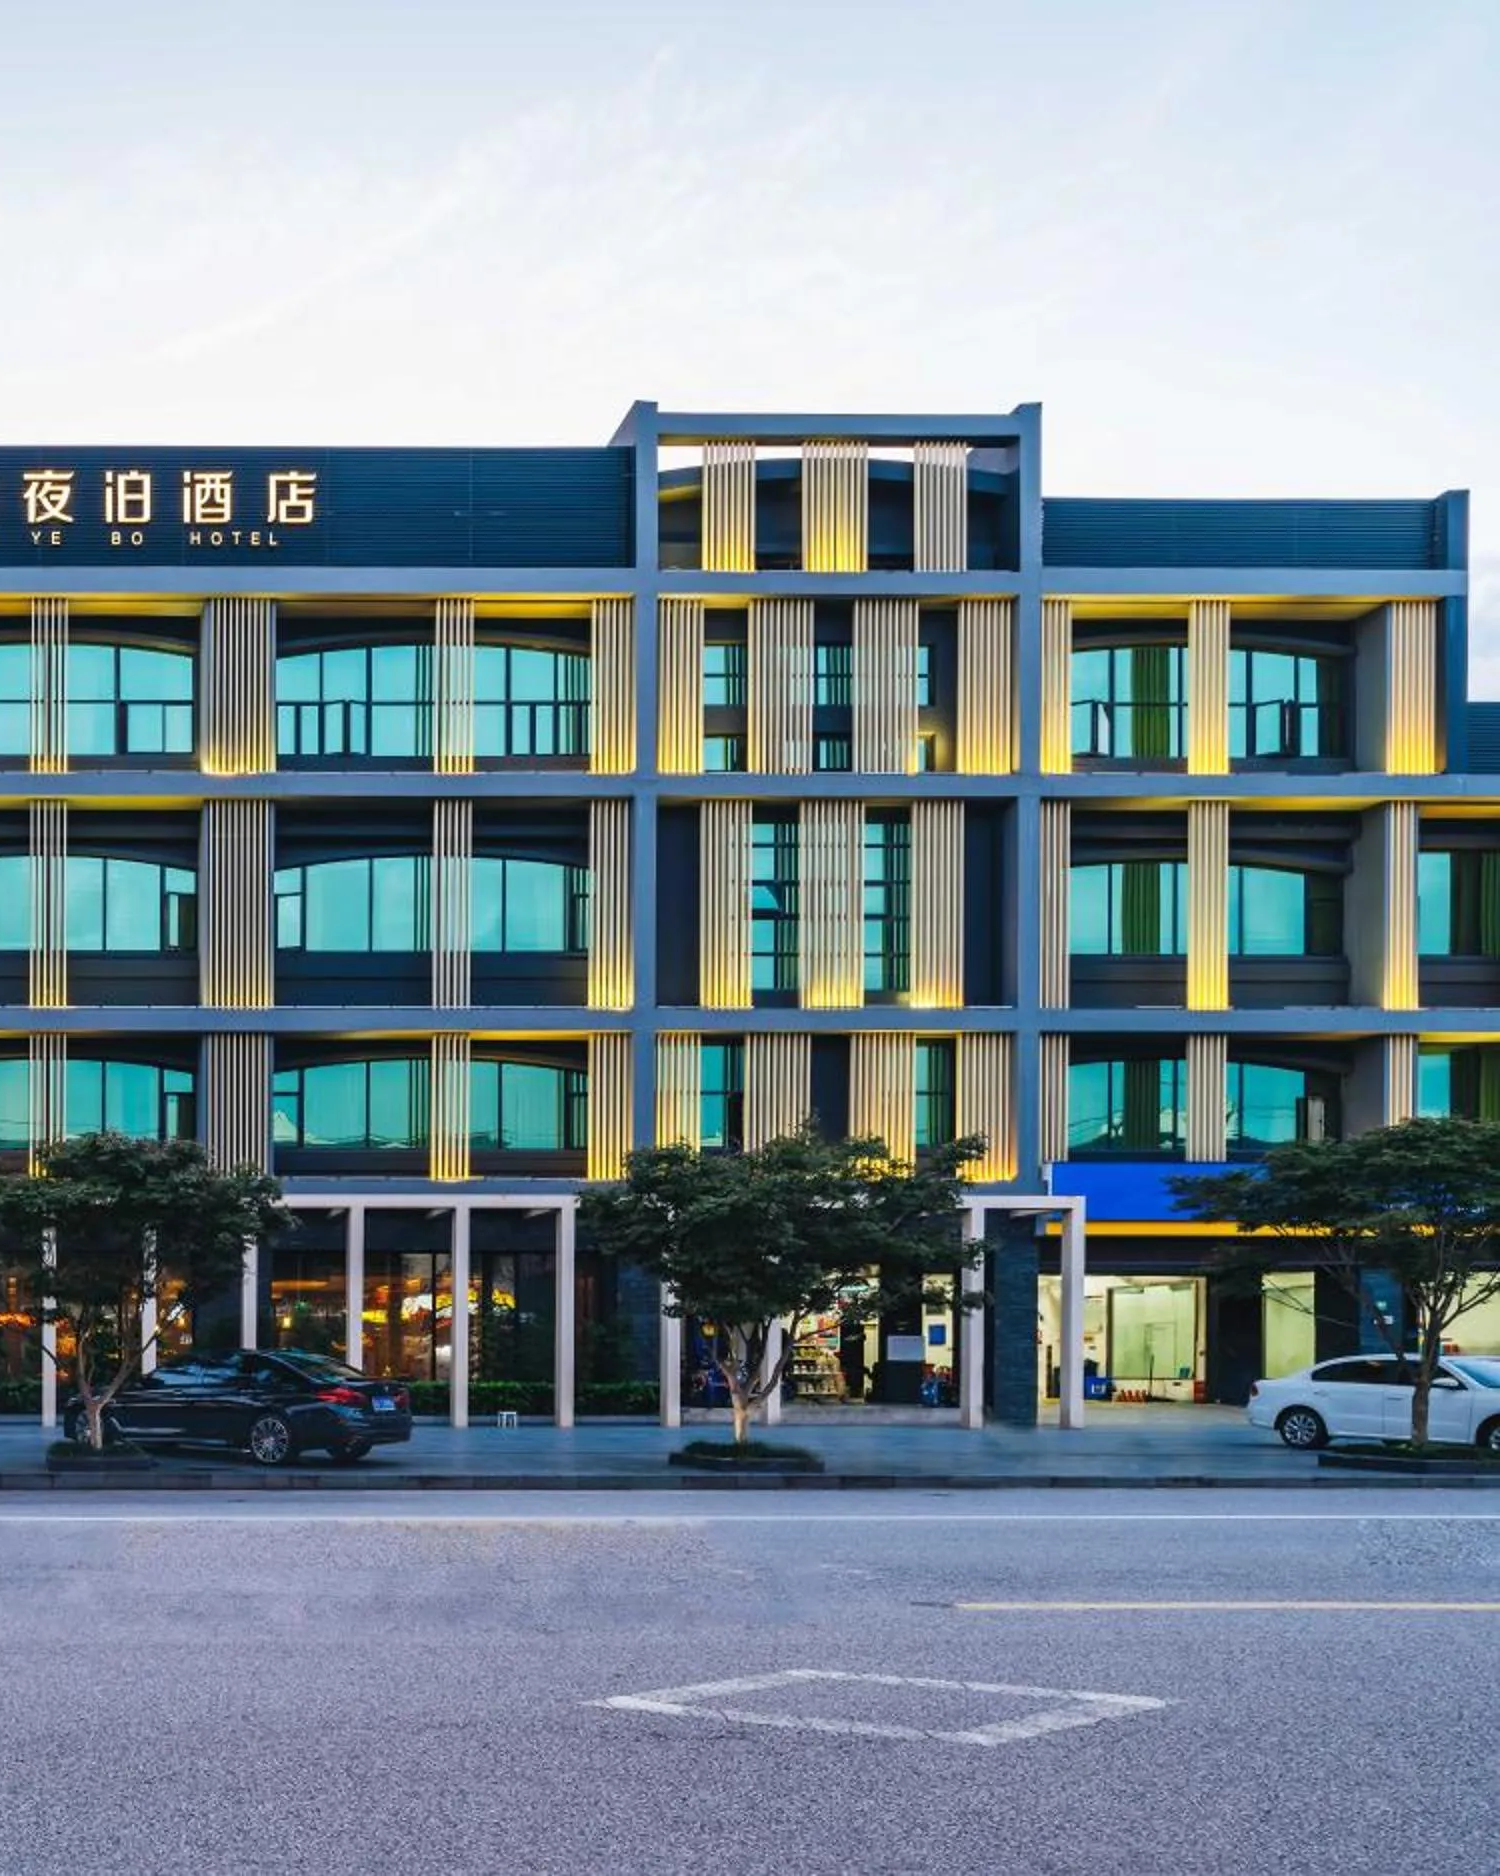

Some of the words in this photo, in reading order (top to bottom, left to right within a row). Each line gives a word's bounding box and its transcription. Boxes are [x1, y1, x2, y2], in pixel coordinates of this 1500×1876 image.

[31, 530, 62, 546] YE
[111, 530, 143, 546] BO
[190, 530, 278, 546] HOTEL
